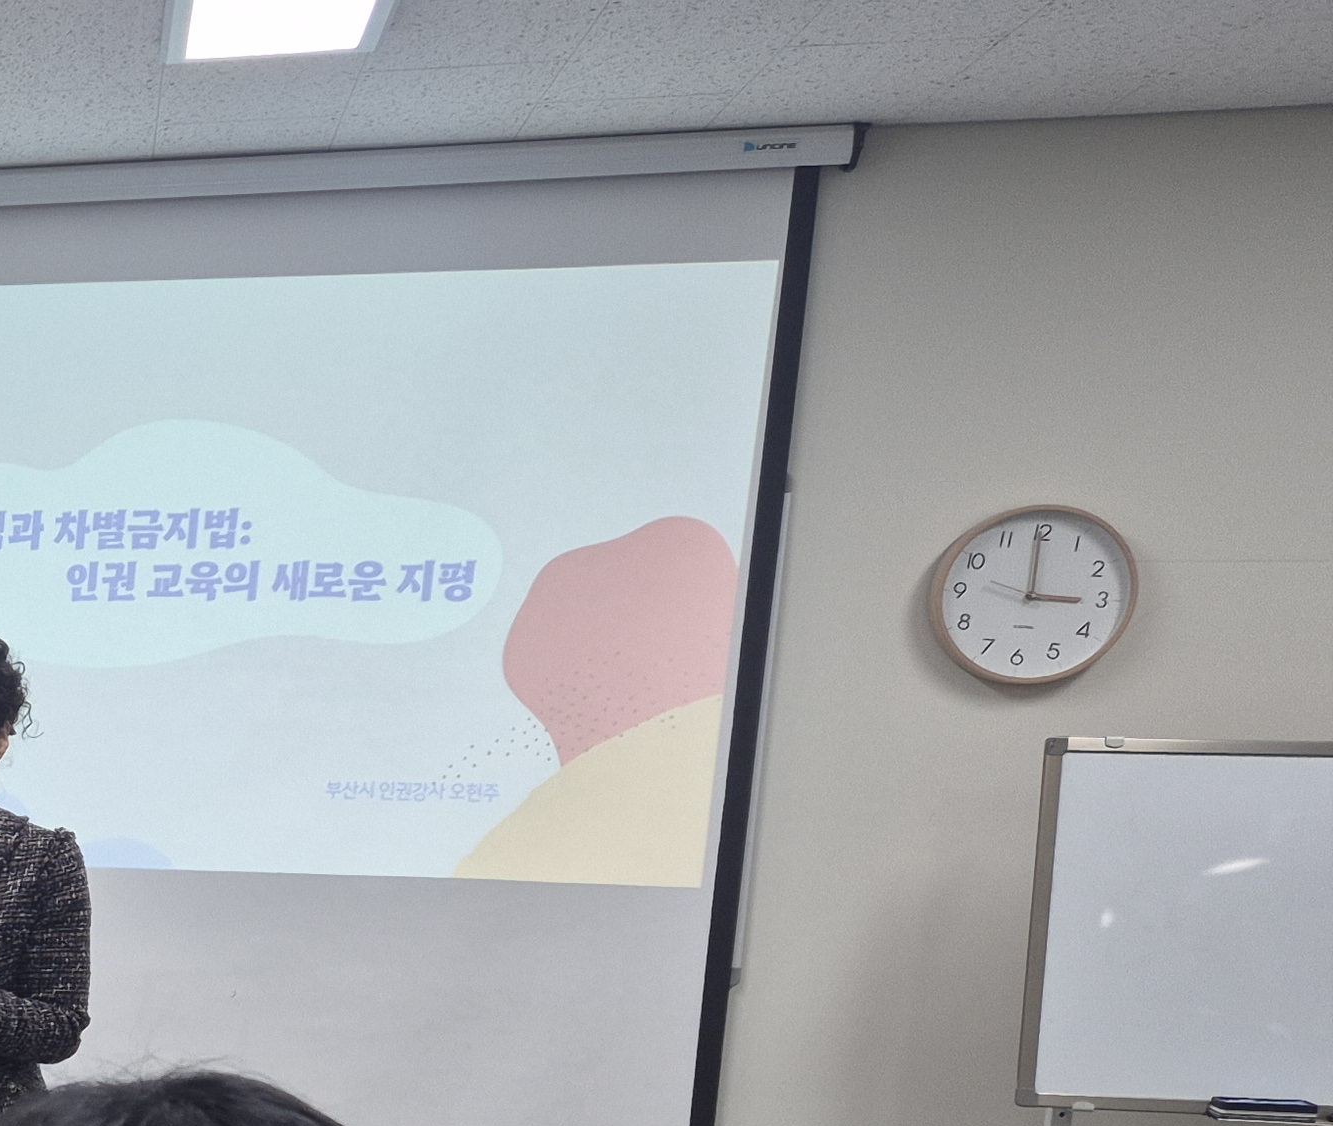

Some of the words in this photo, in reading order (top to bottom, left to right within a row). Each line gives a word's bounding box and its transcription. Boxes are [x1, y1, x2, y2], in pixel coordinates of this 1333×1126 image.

[53, 507, 253, 551] 차별금지법:
[1033, 523, 1053, 542] 12
[999, 530, 1014, 548] 11
[1073, 535, 1082, 552] 1
[966, 552, 986, 570] 10
[1090, 559, 1106, 578] 2
[66, 560, 138, 602] 인권
[146, 559, 262, 602] 교육의
[271, 559, 388, 602] 새로운
[397, 559, 478, 603] 지평
[953, 581, 968, 600] 9
[1094, 590, 1109, 609] 3
[957, 613, 971, 631] 8
[1075, 621, 1092, 639] 4
[980, 638, 996, 655] 7
[1046, 642, 1061, 660] 5
[1009, 648, 1024, 666] 6
[325, 781, 375, 800] 부산시
[379, 781, 446, 802] 인권강사
[449, 783, 501, 803] 오현주
